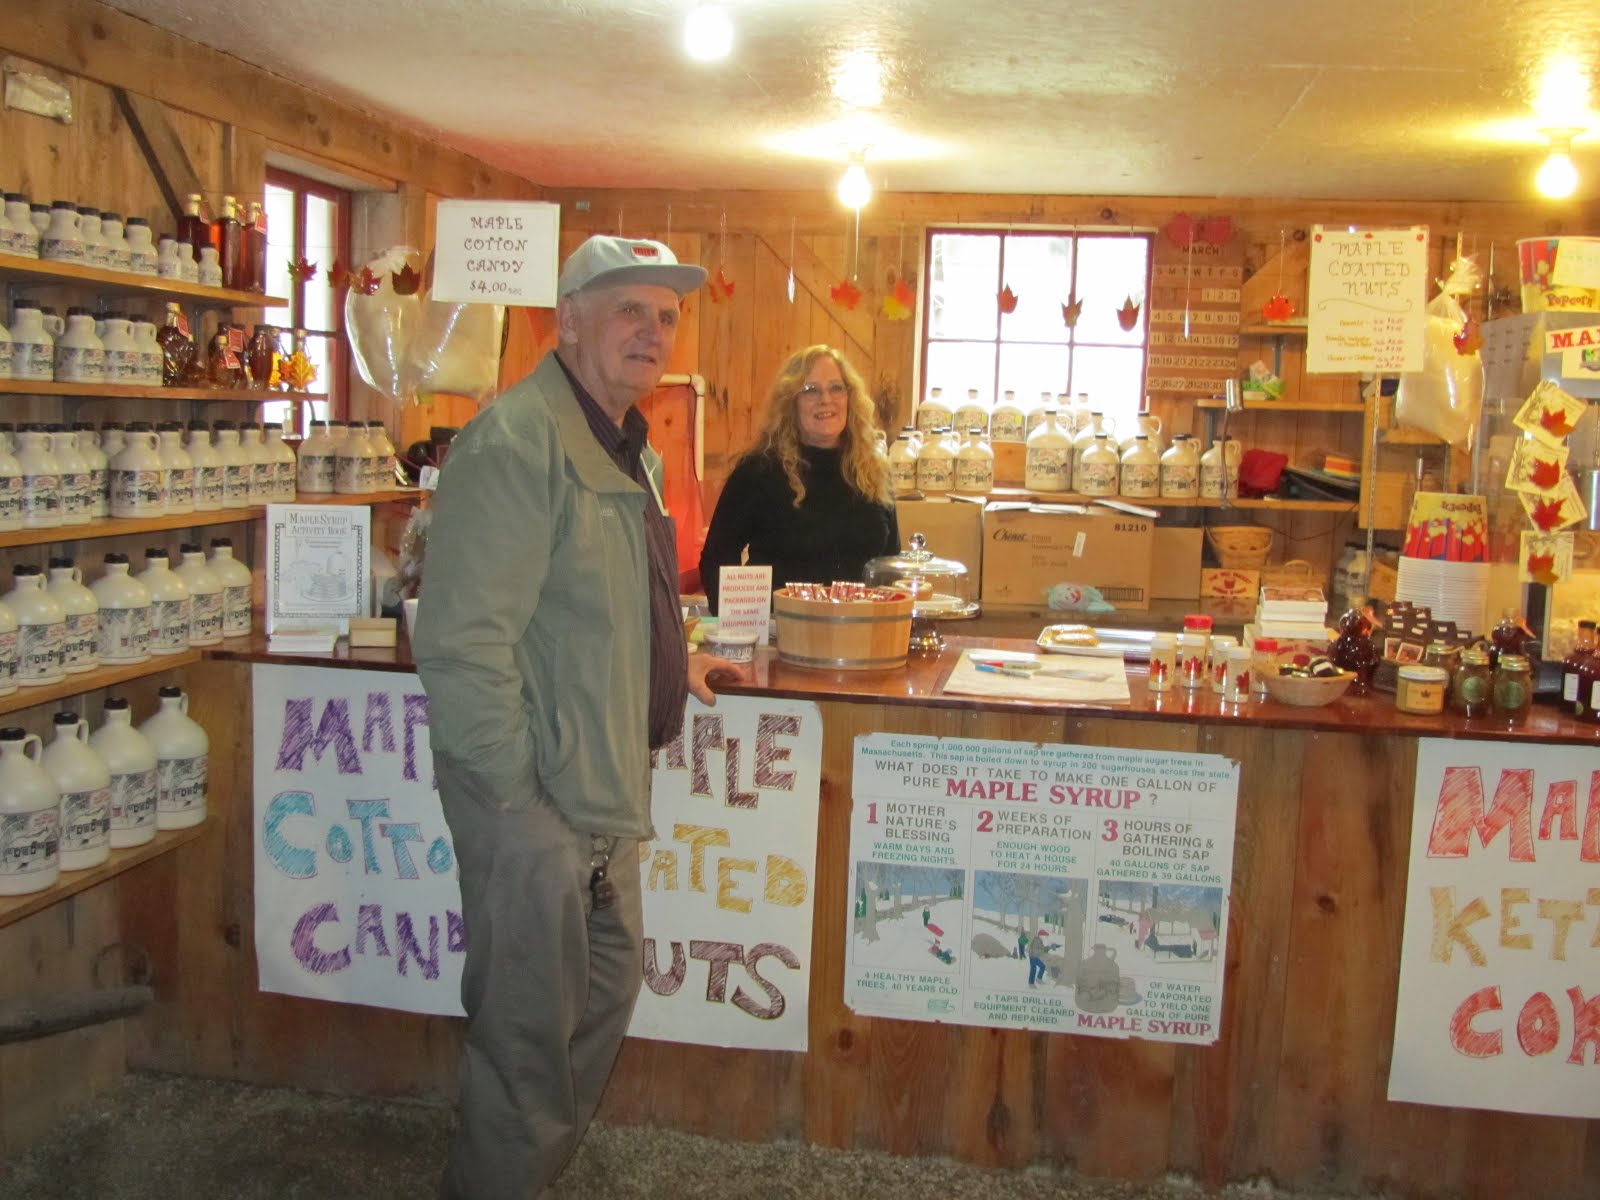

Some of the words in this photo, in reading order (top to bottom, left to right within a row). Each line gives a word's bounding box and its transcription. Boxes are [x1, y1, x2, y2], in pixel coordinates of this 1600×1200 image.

[470, 216, 523, 230] MAPLE
[464, 237, 528, 251] COTTON
[1182, 246, 1219, 255] MARCH
[1331, 241, 1405, 256] MAPLE
[467, 260, 524, 273] CANDY
[1328, 260, 1410, 277] COATED
[469, 280, 507, 294] $4.00
[1342, 281, 1402, 298] NUTS
[1551, 329, 1600, 348] MA
[290, 513, 319, 524] MAPLE
[291, 526, 325, 535] ACTIVITY
[328, 527, 347, 535] BOOK
[1114, 523, 1147, 532] 81210
[274, 692, 434, 784] MAP
[891, 740, 911, 748] Each
[913, 742, 938, 751] spring
[982, 746, 1012, 756] gallons
[1013, 747, 1023, 755] of
[1024, 749, 1039, 757] sap
[1057, 751, 1093, 761] gathered
[1095, 753, 1115, 761] from
[1117, 755, 1142, 764] maple
[1145, 758, 1168, 766] sugar
[1171, 758, 1192, 766] trees
[1195, 759, 1203, 767] in
[861, 747, 925, 758] Massachusetts.
[931, 752, 948, 760] This
[976, 755, 1001, 763] boiled
[1005, 757, 1027, 765] down
[1043, 760, 1067, 769] syrup
[1070, 760, 1078, 768] in
[1101, 763, 1156, 774] sugarhouses
[1160, 768, 1188, 776] across
[1191, 769, 1205, 777] the
[875, 760, 914, 772] WHAT
[922, 763, 958, 775] DOES
[966, 767, 978, 777] IT
[987, 768, 1021, 780] TAKE
[1030, 770, 1048, 781] TO
[1055, 772, 1093, 785] MAKE
[1101, 775, 1129, 787] ONE
[1136, 778, 1192, 791] GALLON
[1198, 782, 1217, 793] OF
[903, 776, 940, 788] PURE
[946, 778, 1038, 802] MAPLE
[1049, 784, 1141, 810] SYRUP
[1150, 794, 1158, 805] ?
[867, 802, 879, 824] 1
[886, 803, 945, 818] MOTHER
[886, 816, 957, 831] NATURE'S
[976, 810, 994, 833] 2
[998, 810, 1048, 824] WEEKS
[1053, 815, 1072, 826] OF
[263, 790, 452, 880] COTTO
[885, 829, 950, 843] BLESSING
[996, 823, 1091, 840] PREPARATION
[1101, 819, 1119, 842] 3
[1124, 820, 1171, 833] HOURS
[1174, 823, 1193, 834] OF
[996, 841, 1037, 851] ENOUGH
[1040, 844, 1071, 854] WOOD
[1123, 833, 1201, 848] GATHERING
[1205, 839, 1214, 849] &
[874, 842, 903, 851] WARM
[906, 844, 931, 854] DAYS
[935, 847, 954, 856] AND
[1122, 845, 1177, 858] BOILING
[1182, 850, 1210, 860] SAP
[872, 852, 917, 862] FREEZING
[990, 850, 1003, 858] TO
[1005, 851, 1031, 860] HEAT
[1034, 853, 1041, 861] A
[1044, 854, 1077, 864] HOUSE
[639, 823, 809, 914] ATED
[997, 860, 1017, 869] FOR
[1020, 862, 1030, 870] 24
[1124, 860, 1169, 870] GALLONS
[1173, 863, 1186, 871] OF
[1191, 864, 1210, 873] SAP
[1096, 868, 1149, 878] GATHERED
[1161, 872, 1172, 880] 39
[1175, 873, 1221, 883] GALLONS
[291, 902, 467, 981] CAND
[642, 938, 801, 1020] UTS
[873, 972, 916, 982] HEALTHY
[919, 975, 951, 985] MAPLE
[905, 983, 936, 993] YEARS
[1150, 981, 1162, 990] OF
[1166, 983, 1200, 993] WATER
[994, 994, 1019, 1003] TAPS
[1147, 991, 1212, 1003] EVAPORATED
[974, 1002, 1027, 1013] EQUIPMENT
[1031, 1006, 1075, 1017] CLEANED
[1144, 1000, 1157, 1008] TO
[1160, 1001, 1187, 1011] YIELD
[1191, 1004, 1210, 1013] ONE
[988, 1012, 1008, 1021] AND
[1011, 1014, 1058, 1024] REPAIRED
[1126, 1008, 1165, 1019] GALLON
[1168, 1011, 1181, 1020] OF
[1185, 1012, 1210, 1022] PURE
[1077, 1013, 1142, 1032] MAPLE
[1147, 1019, 1212, 1036] SYRUP
[1449, 984, 1600, 1066] COR
